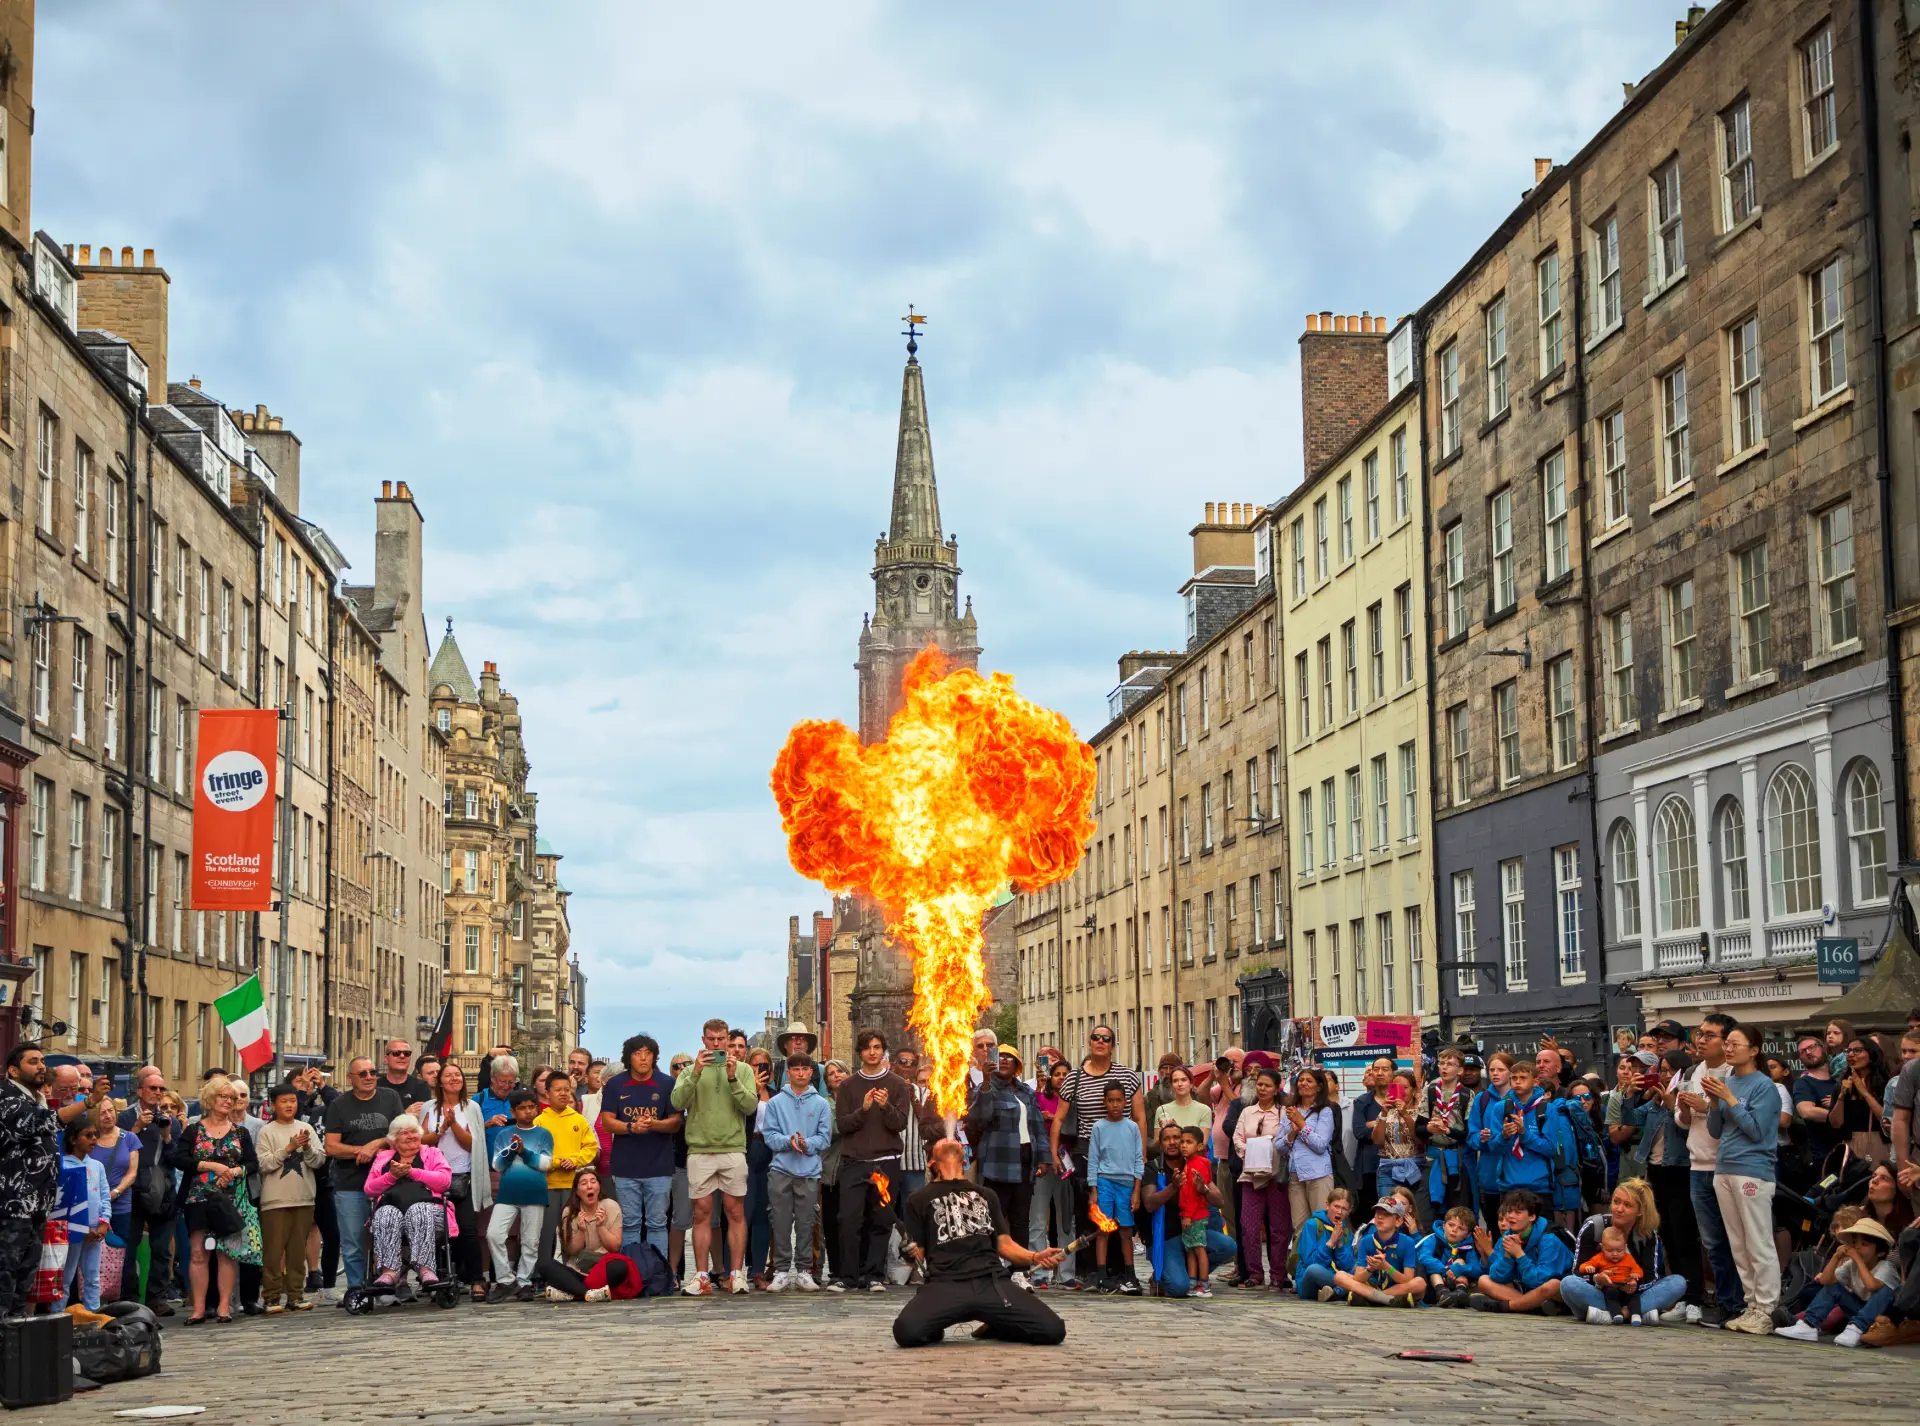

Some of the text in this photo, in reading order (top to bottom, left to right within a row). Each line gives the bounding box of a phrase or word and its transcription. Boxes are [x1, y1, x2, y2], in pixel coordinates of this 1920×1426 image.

[208, 769, 263, 792] fringe
[214, 789, 240, 798] street
[215, 795, 244, 804] events
[205, 853, 260, 866] Scotland
[241, 866, 259, 874] Stage
[1822, 945, 1854, 963] 166
[1822, 967, 1856, 976] High Street
[1678, 984, 1792, 1003] ROYAL MILE FACTORY OUTLET
[1322, 1021, 1356, 1038] fringe
[1322, 1048, 1391, 1059] TODAY'S PERFORMERS
[1761, 1041, 1784, 1056] OOL,
[623, 1106, 658, 1116] QATAR
